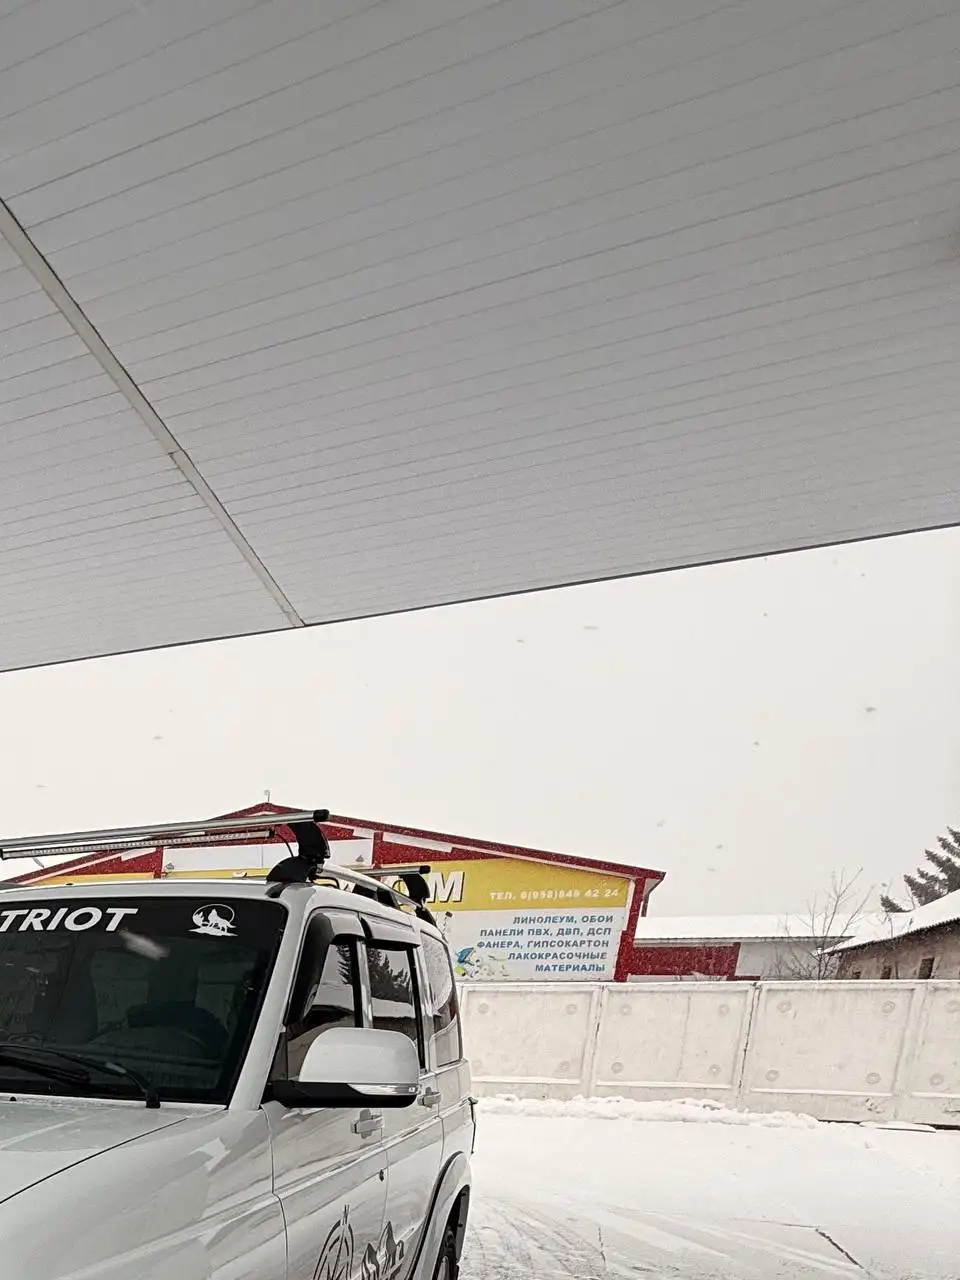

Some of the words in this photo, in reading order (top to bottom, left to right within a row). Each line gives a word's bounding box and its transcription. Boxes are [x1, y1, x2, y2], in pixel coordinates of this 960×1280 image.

[490, 891, 516, 901] ТЕЛ.
[584, 889, 600, 898] 42
[604, 888, 619, 897] 24
[512, 915, 577, 925] ЛИНОЛЕУМ,
[581, 915, 614, 923] ОБОИ
[479, 928, 524, 937] ПАНЕЛИ
[527, 928, 553, 937] ПВХ,
[556, 927, 583, 937] ДВП,
[586, 927, 612, 937] ДСП
[476, 940, 523, 949] ФАНЕРА,
[527, 939, 610, 949] ГИПСОКАРТОН
[507, 951, 608, 960] ЛАКОКРАСОЧНЫЕ
[535, 964, 605, 972] МАТЕРИАЛЫ
